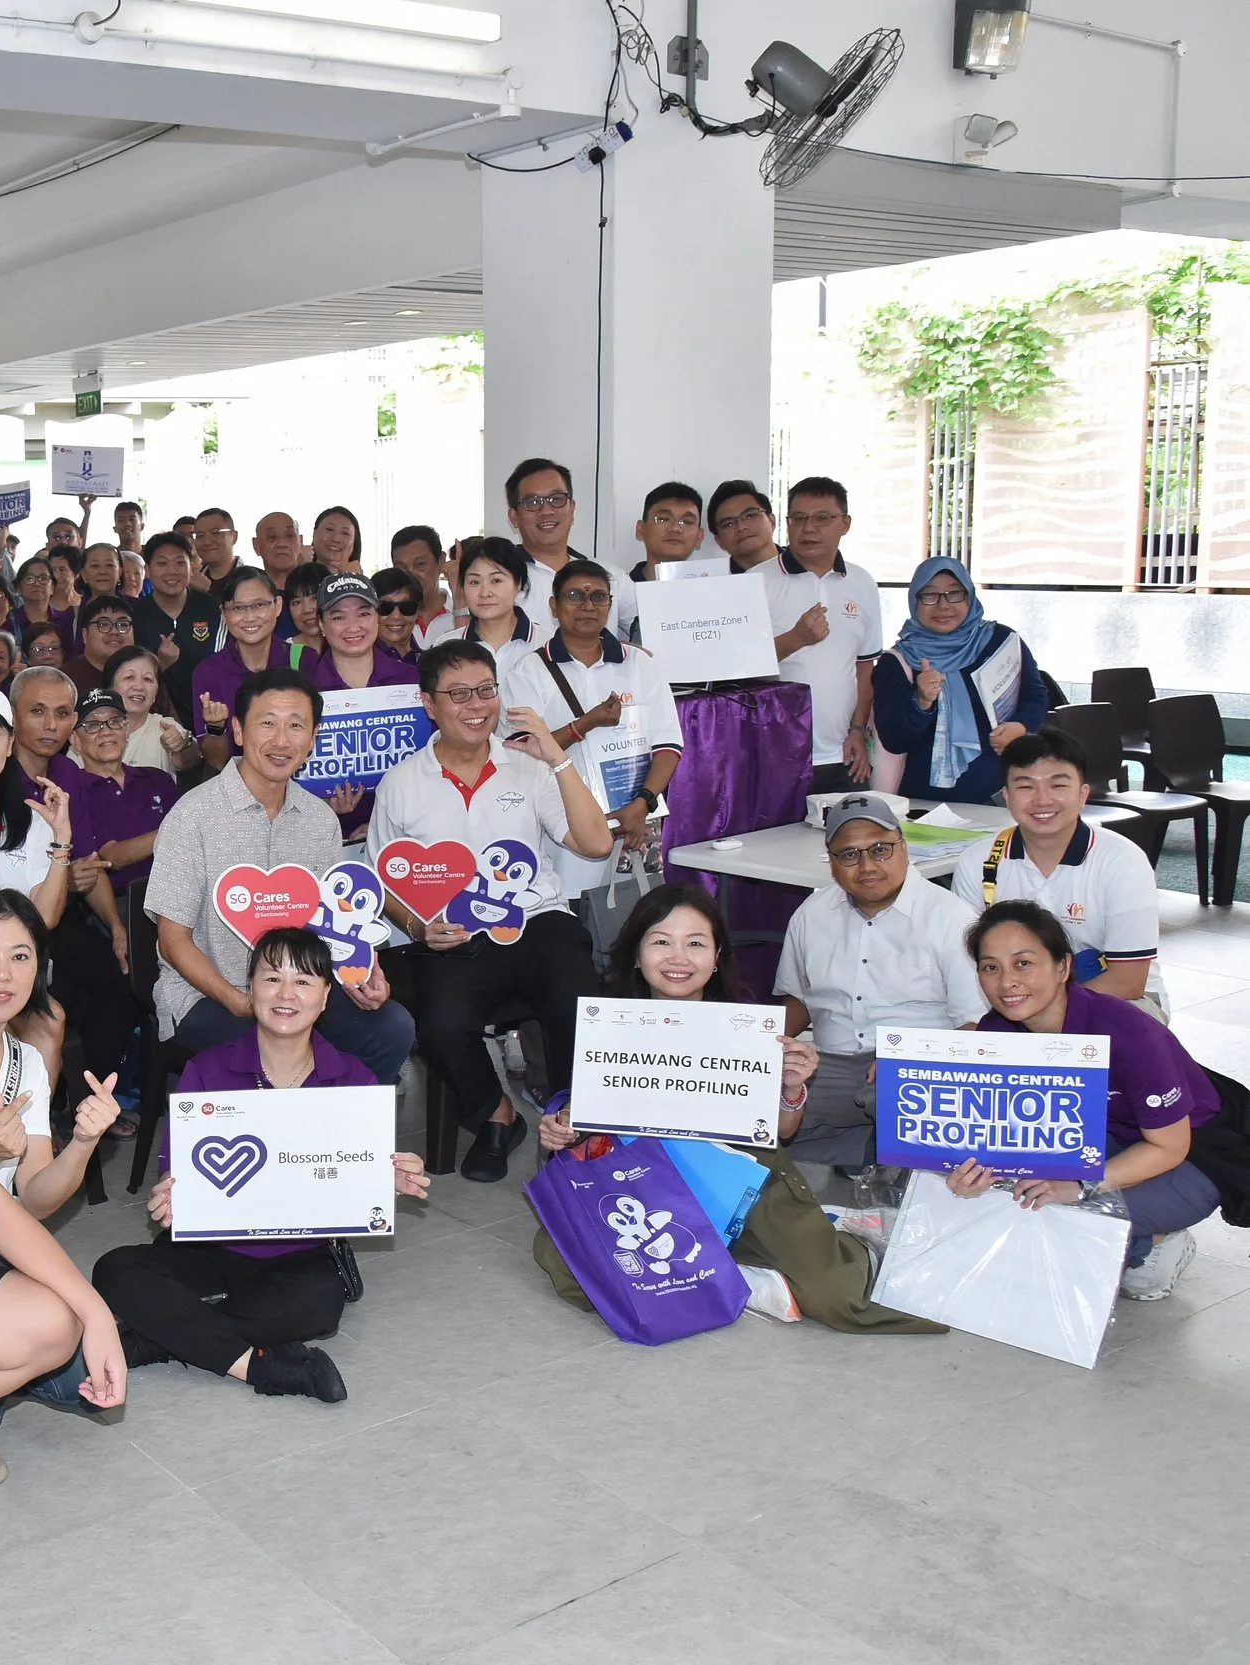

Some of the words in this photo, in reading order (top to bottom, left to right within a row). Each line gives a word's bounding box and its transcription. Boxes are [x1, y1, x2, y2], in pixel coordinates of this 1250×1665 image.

[78, 395, 95, 413] EXIT
[661, 622, 679, 631] East
[680, 619, 720, 630] Canberra
[721, 616, 742, 626] Zone
[744, 615, 749, 623] 1
[692, 630, 721, 642] (ECZ1)
[366, 714, 416, 726] CENTRAL
[315, 725, 417, 758] ENIOR
[601, 737, 647, 753] VOLUNTEER
[389, 864, 406, 873] SG
[412, 862, 448, 873] Cares
[230, 893, 247, 904] SG
[253, 892, 290, 903] Cares
[585, 1050, 692, 1068] SEMBAWANG
[700, 1056, 772, 1074] CENTRAL
[897, 1067, 1003, 1085] SEMBAWANG
[1007, 1074, 1085, 1087] CENTRAL
[602, 1075, 660, 1090] SENIOR
[665, 1078, 749, 1097] PROFILING
[202, 1105, 214, 1113] SG
[897, 1083, 1084, 1126] SENIOR
[897, 1115, 1084, 1151] PROFILING
[278, 1151, 332, 1164] Blossom
[336, 1150, 375, 1163] Seeds
[313, 1167, 338, 1179] 福善
